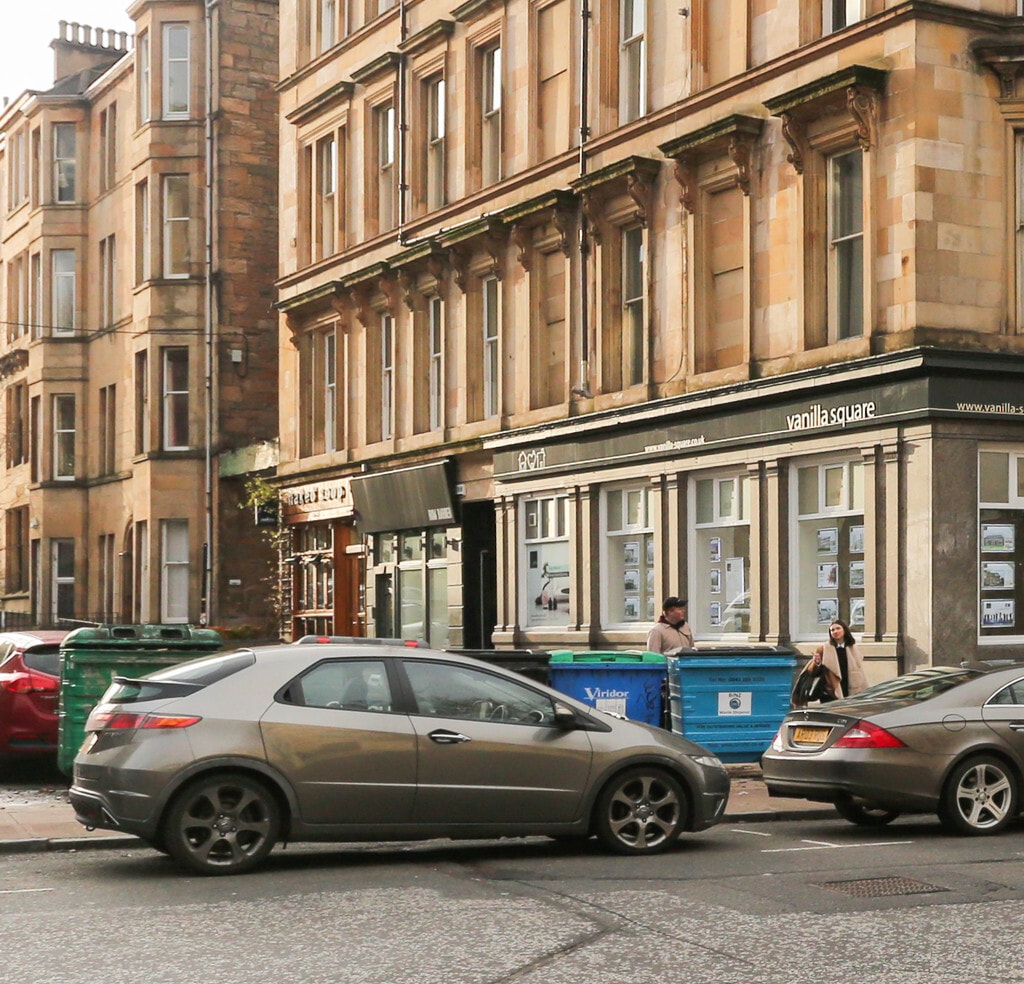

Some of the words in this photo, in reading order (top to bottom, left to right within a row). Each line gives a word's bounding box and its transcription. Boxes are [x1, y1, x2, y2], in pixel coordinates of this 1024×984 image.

[787, 404, 829, 431] vanilla
[829, 401, 875, 428] square
[583, 687, 630, 701] Viridor
